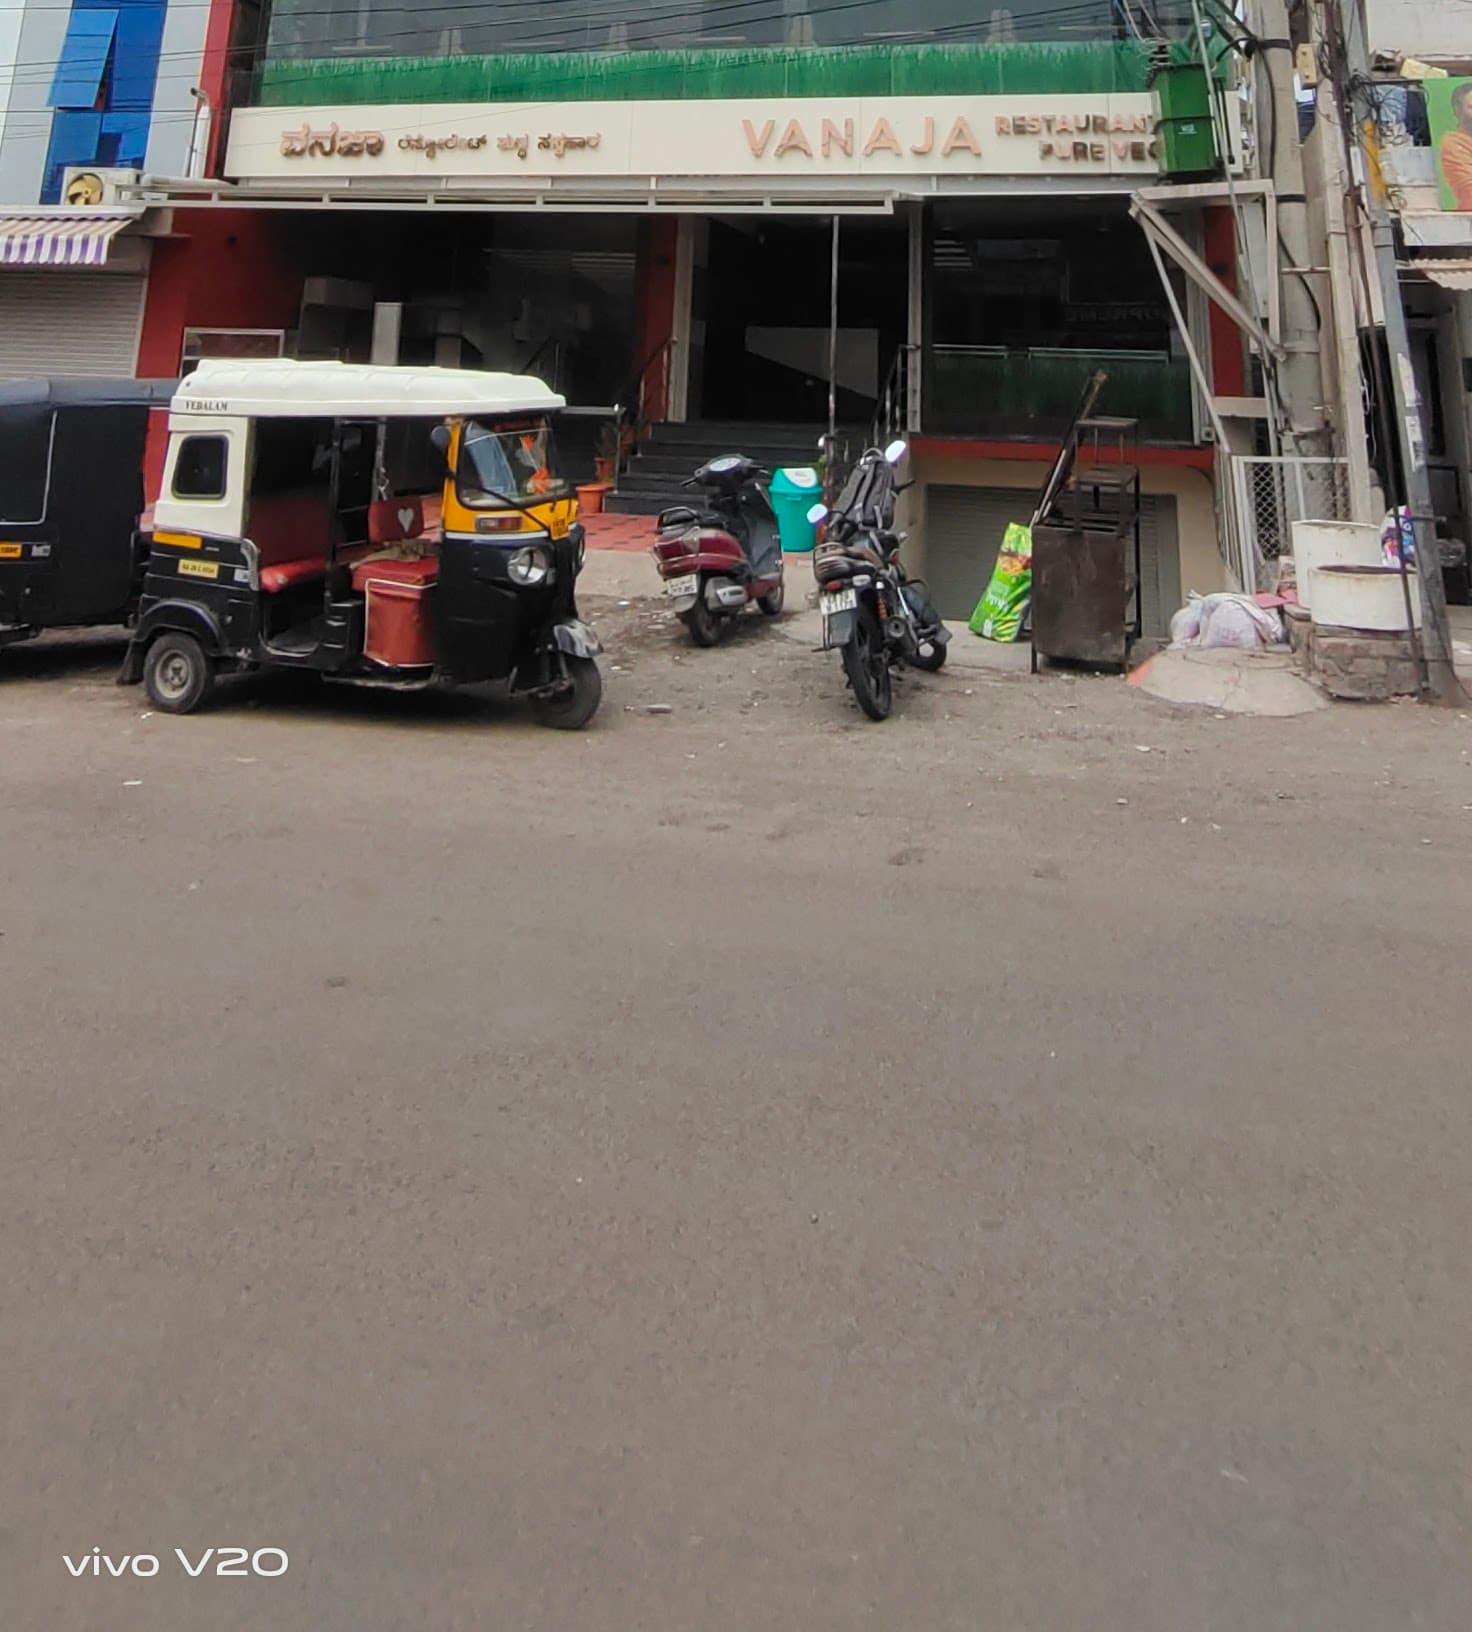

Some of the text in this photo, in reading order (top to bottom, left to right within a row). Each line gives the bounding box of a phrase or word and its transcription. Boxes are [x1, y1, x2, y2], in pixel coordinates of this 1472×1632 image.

[741, 114, 1153, 159] VANAJA RESTAURAN
[1039, 141, 1105, 162] PURE
